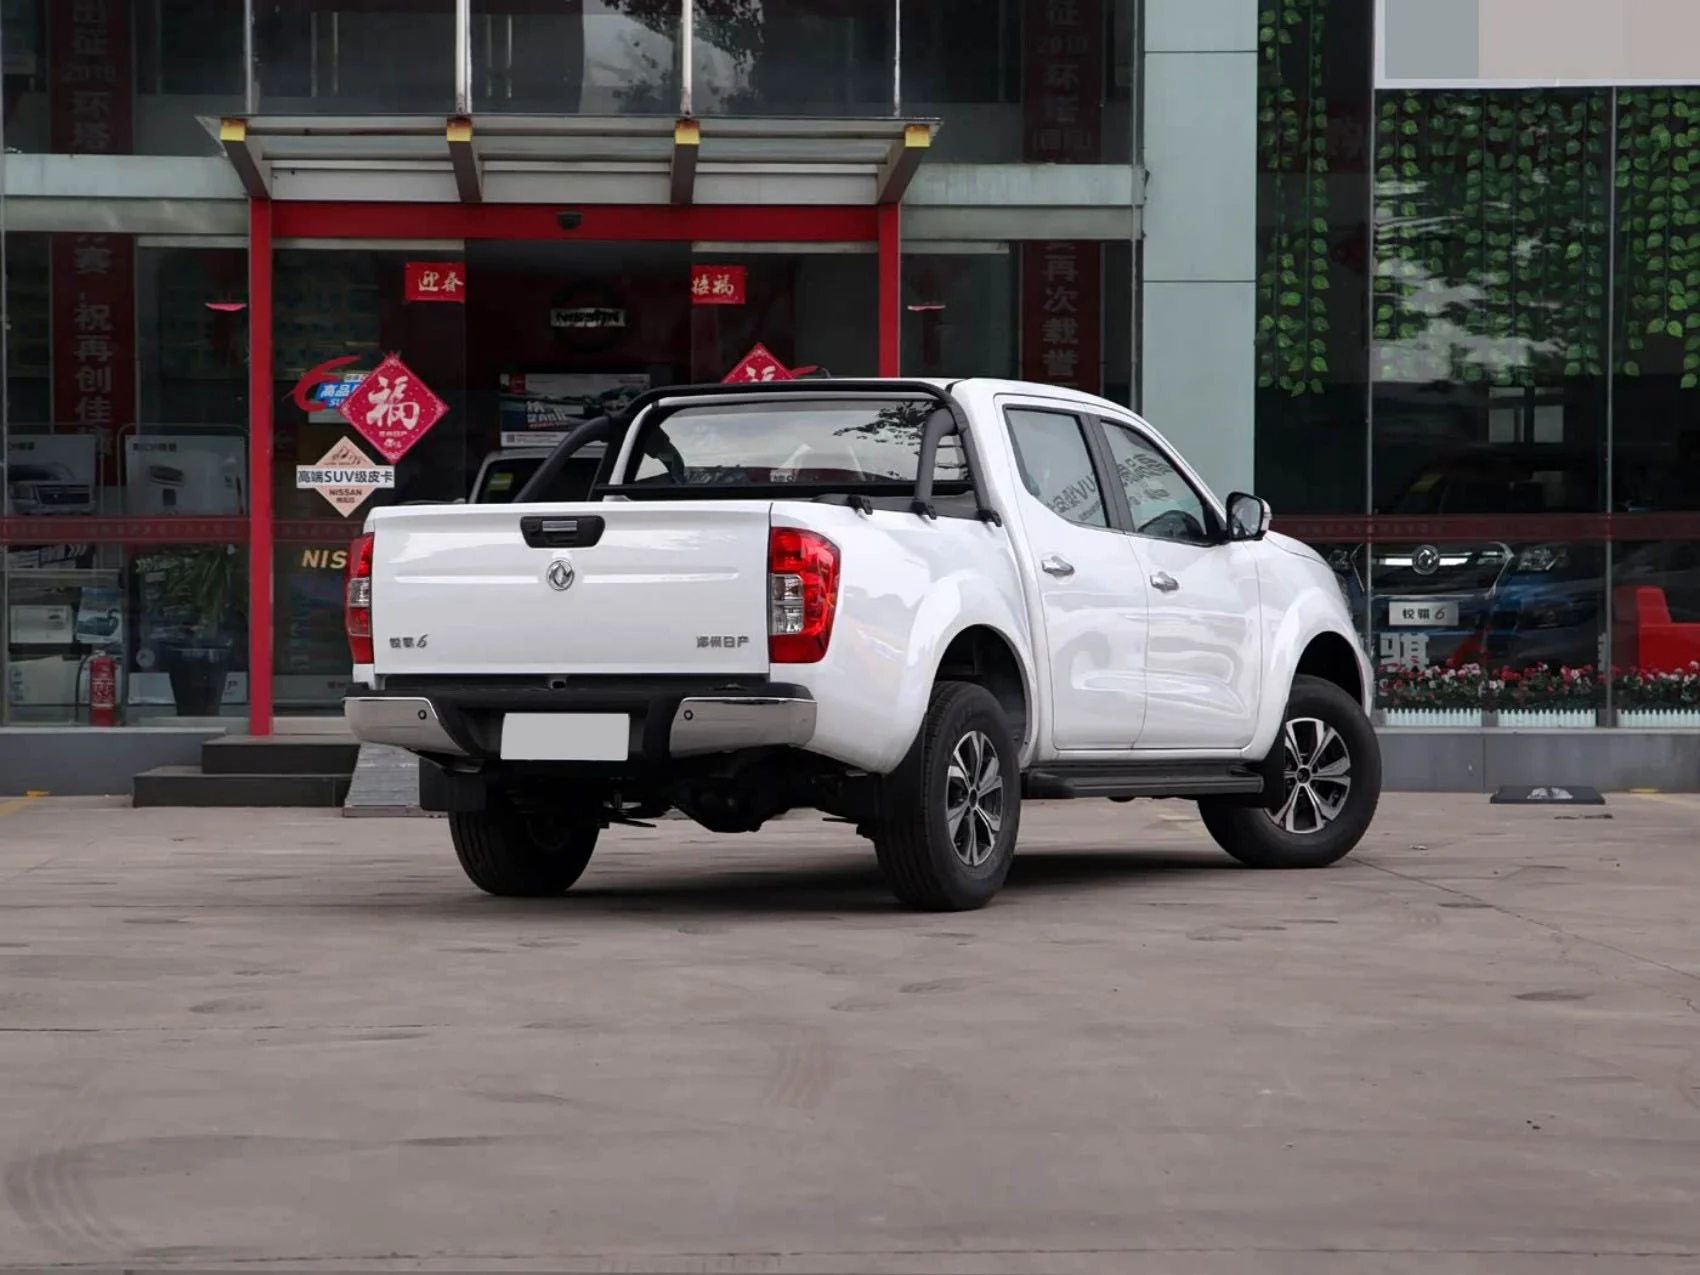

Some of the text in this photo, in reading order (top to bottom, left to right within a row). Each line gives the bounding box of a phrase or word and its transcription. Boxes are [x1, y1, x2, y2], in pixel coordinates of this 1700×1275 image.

[418, 270, 464, 292] 迎春
[1041, 243, 1080, 386] 再次载誉
[366, 375, 420, 430] 福
[298, 469, 394, 484] 高端SUV级皮卡
[329, 488, 363, 497] NISSAN
